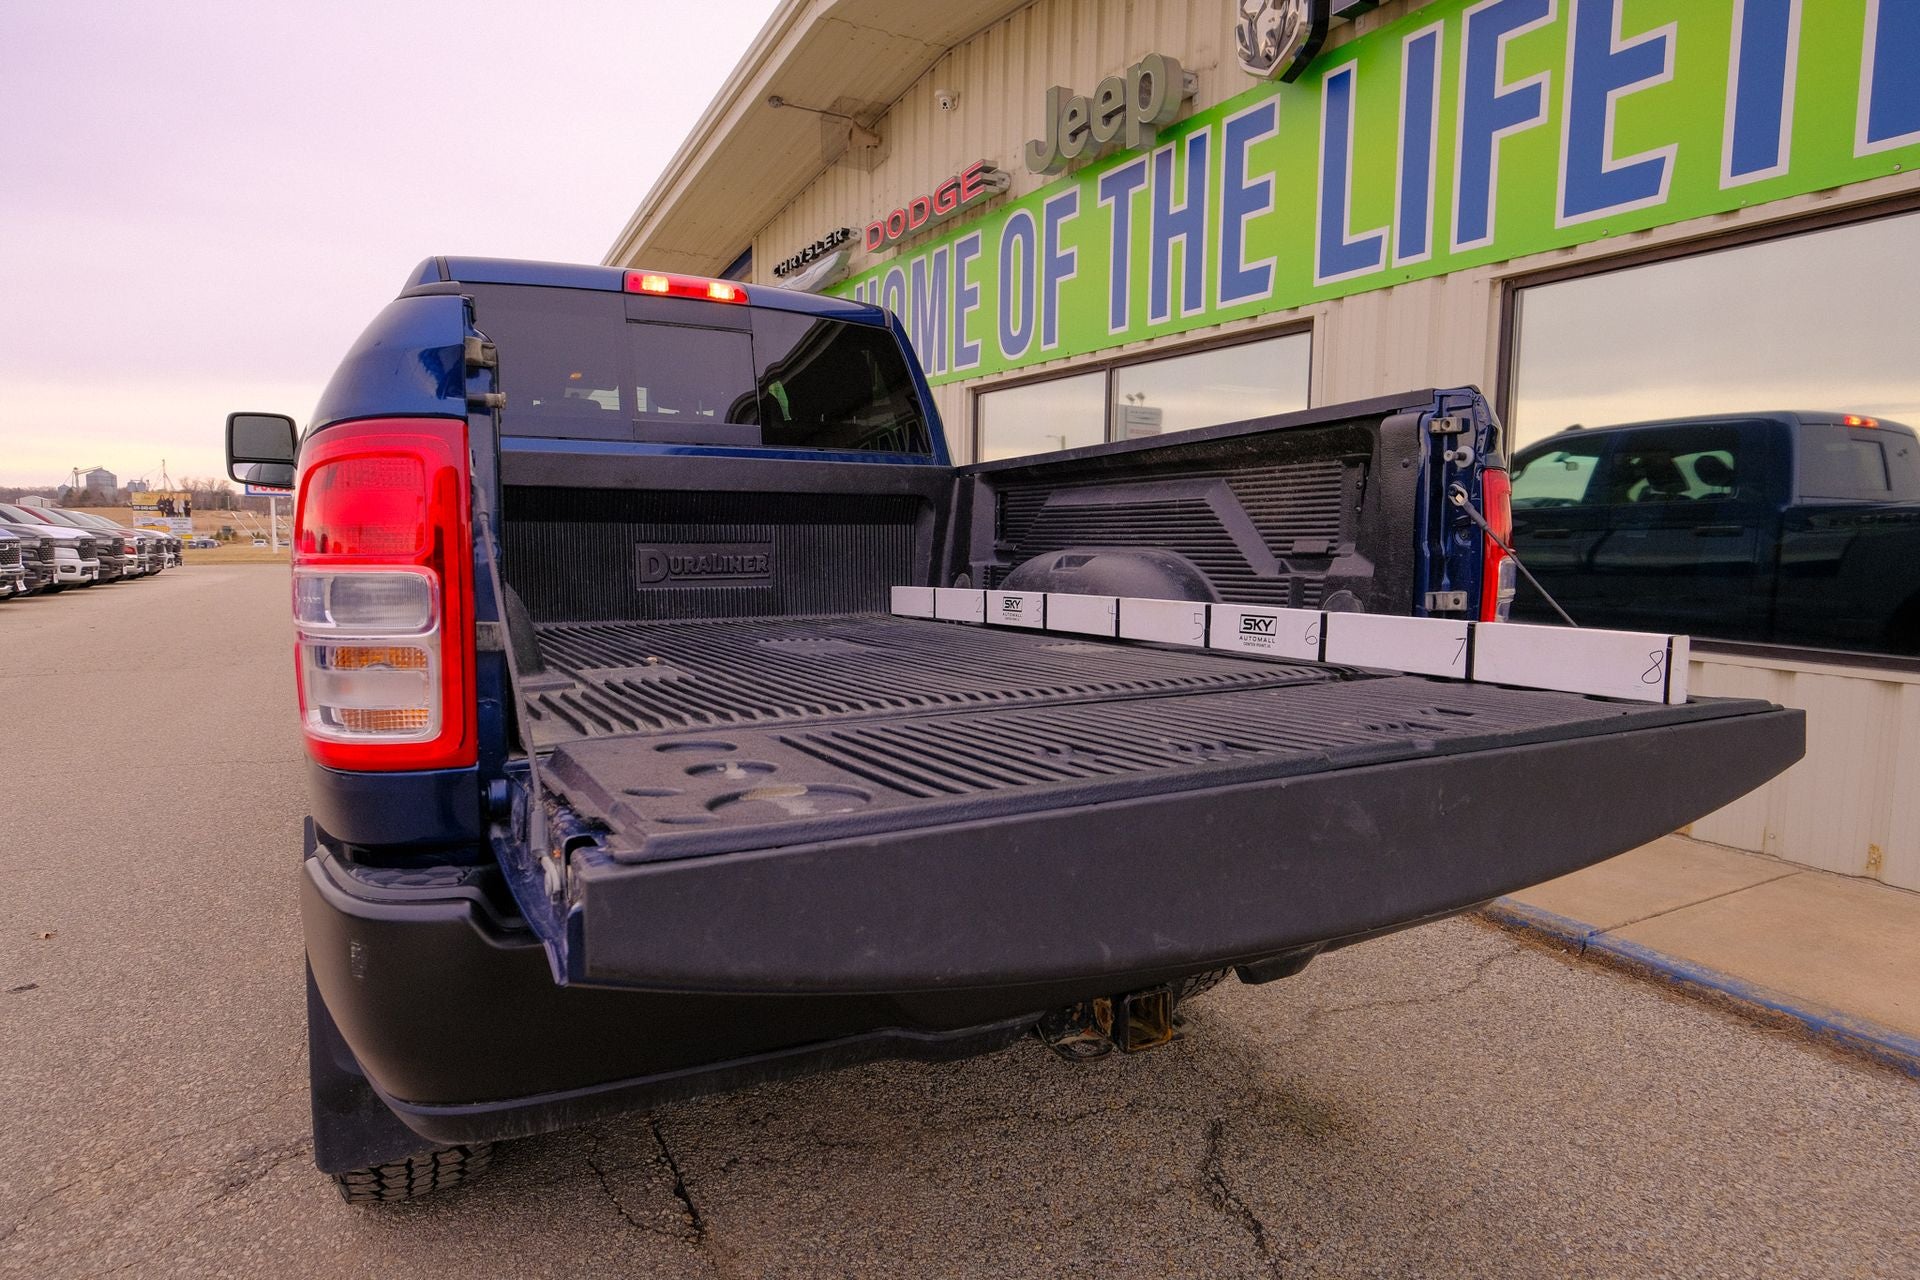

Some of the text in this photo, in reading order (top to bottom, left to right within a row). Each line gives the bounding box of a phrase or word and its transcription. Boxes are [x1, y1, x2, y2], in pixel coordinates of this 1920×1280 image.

[1025, 52, 1173, 175] Jeep
[854, 0, 1920, 377] OME OF THE LIFE
[865, 158, 987, 253] DODGE
[772, 227, 847, 278] CHRYSLER
[975, 595, 983, 613] 2
[1004, 599, 1021, 609] SKY
[1033, 600, 1042, 623] 3
[1107, 605, 1117, 633] 4
[1192, 612, 1203, 640] 5
[1242, 618, 1273, 632] SKY
[1239, 635, 1275, 644] AUTOMALL
[1305, 622, 1318, 645] 6
[1452, 637, 1467, 666] 7
[1641, 650, 1665, 685] 8
